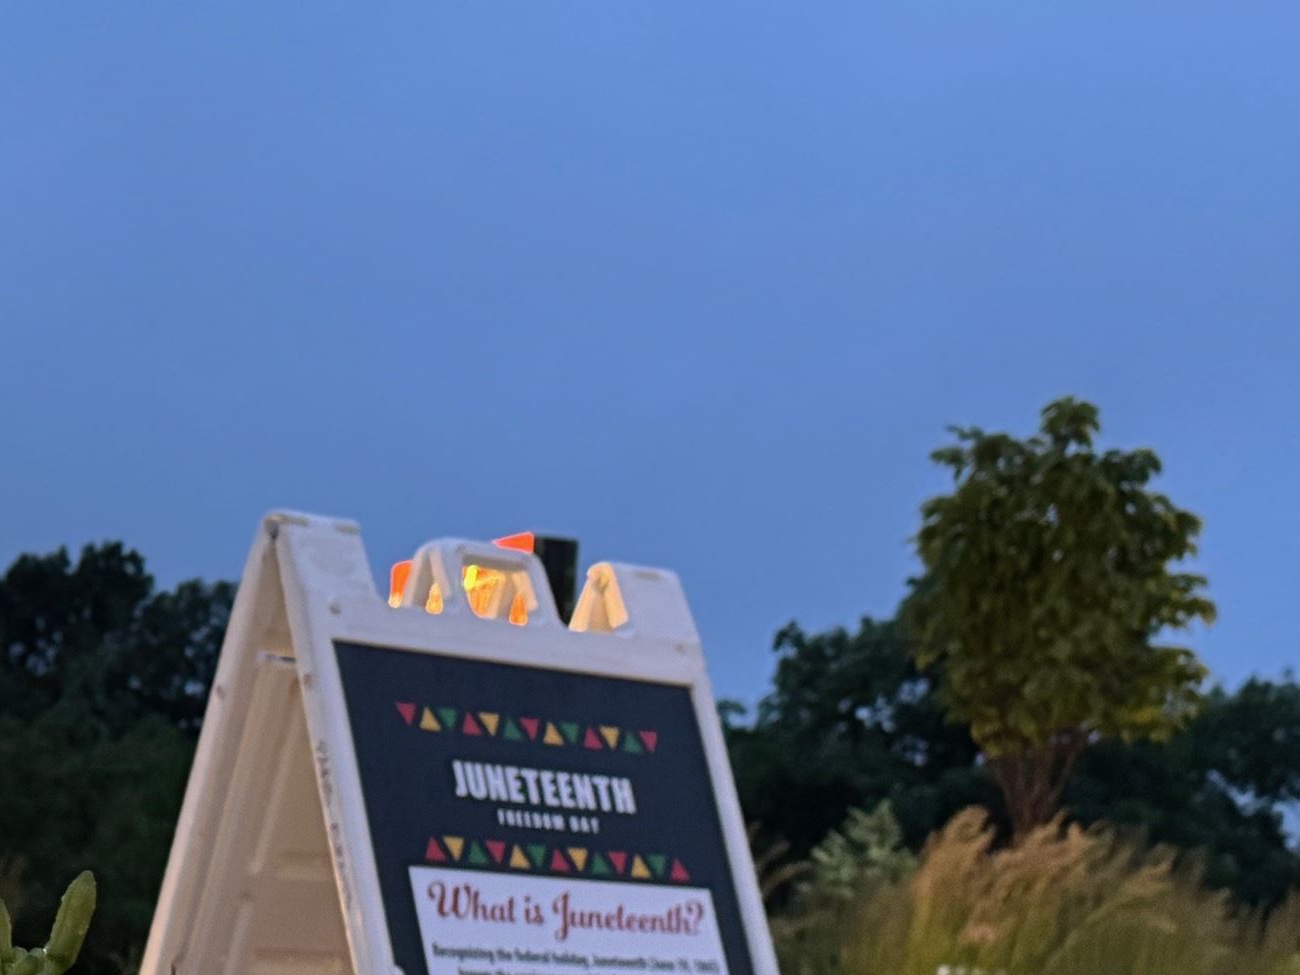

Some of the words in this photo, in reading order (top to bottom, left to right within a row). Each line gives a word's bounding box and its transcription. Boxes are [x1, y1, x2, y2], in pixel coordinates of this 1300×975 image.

[453, 760, 636, 815] JUNETEENTH
[497, 808, 565, 831] FREEDOM
[569, 815, 599, 834] DAY
[427, 881, 515, 922] What
[524, 896, 544, 925] is
[552, 890, 704, 941] Juneteenth?
